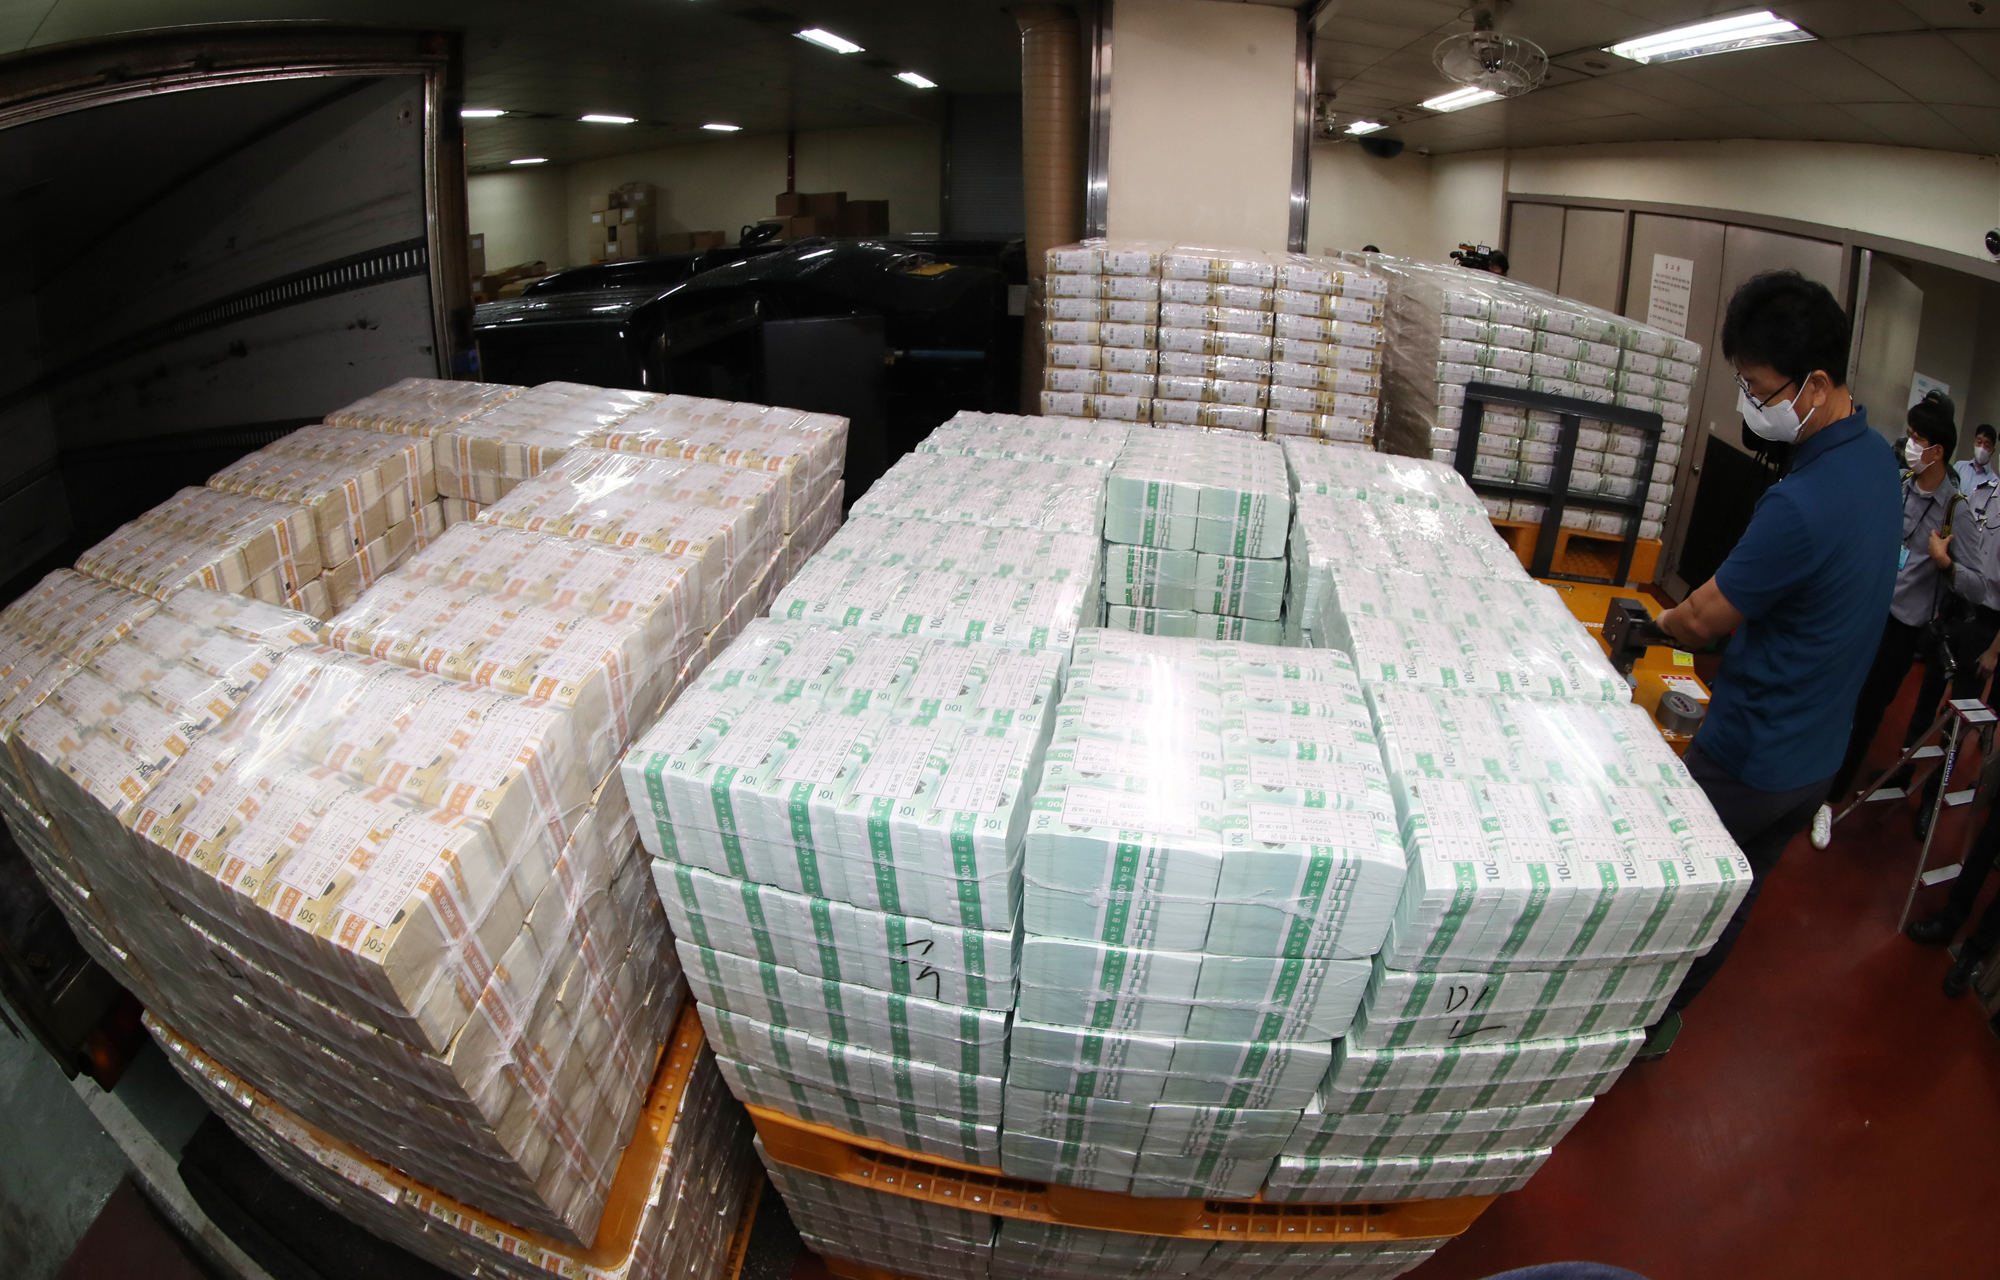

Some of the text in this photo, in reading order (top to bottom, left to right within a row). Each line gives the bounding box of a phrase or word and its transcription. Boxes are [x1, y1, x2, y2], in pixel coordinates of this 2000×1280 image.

[152, 824, 164, 835] 50
[194, 848, 208, 861] 50
[314, 835, 356, 887] 한국은행 오만원권
[241, 875, 257, 888] 50
[403, 860, 426, 888] 한국은행
[382, 886, 407, 916] 오만원권
